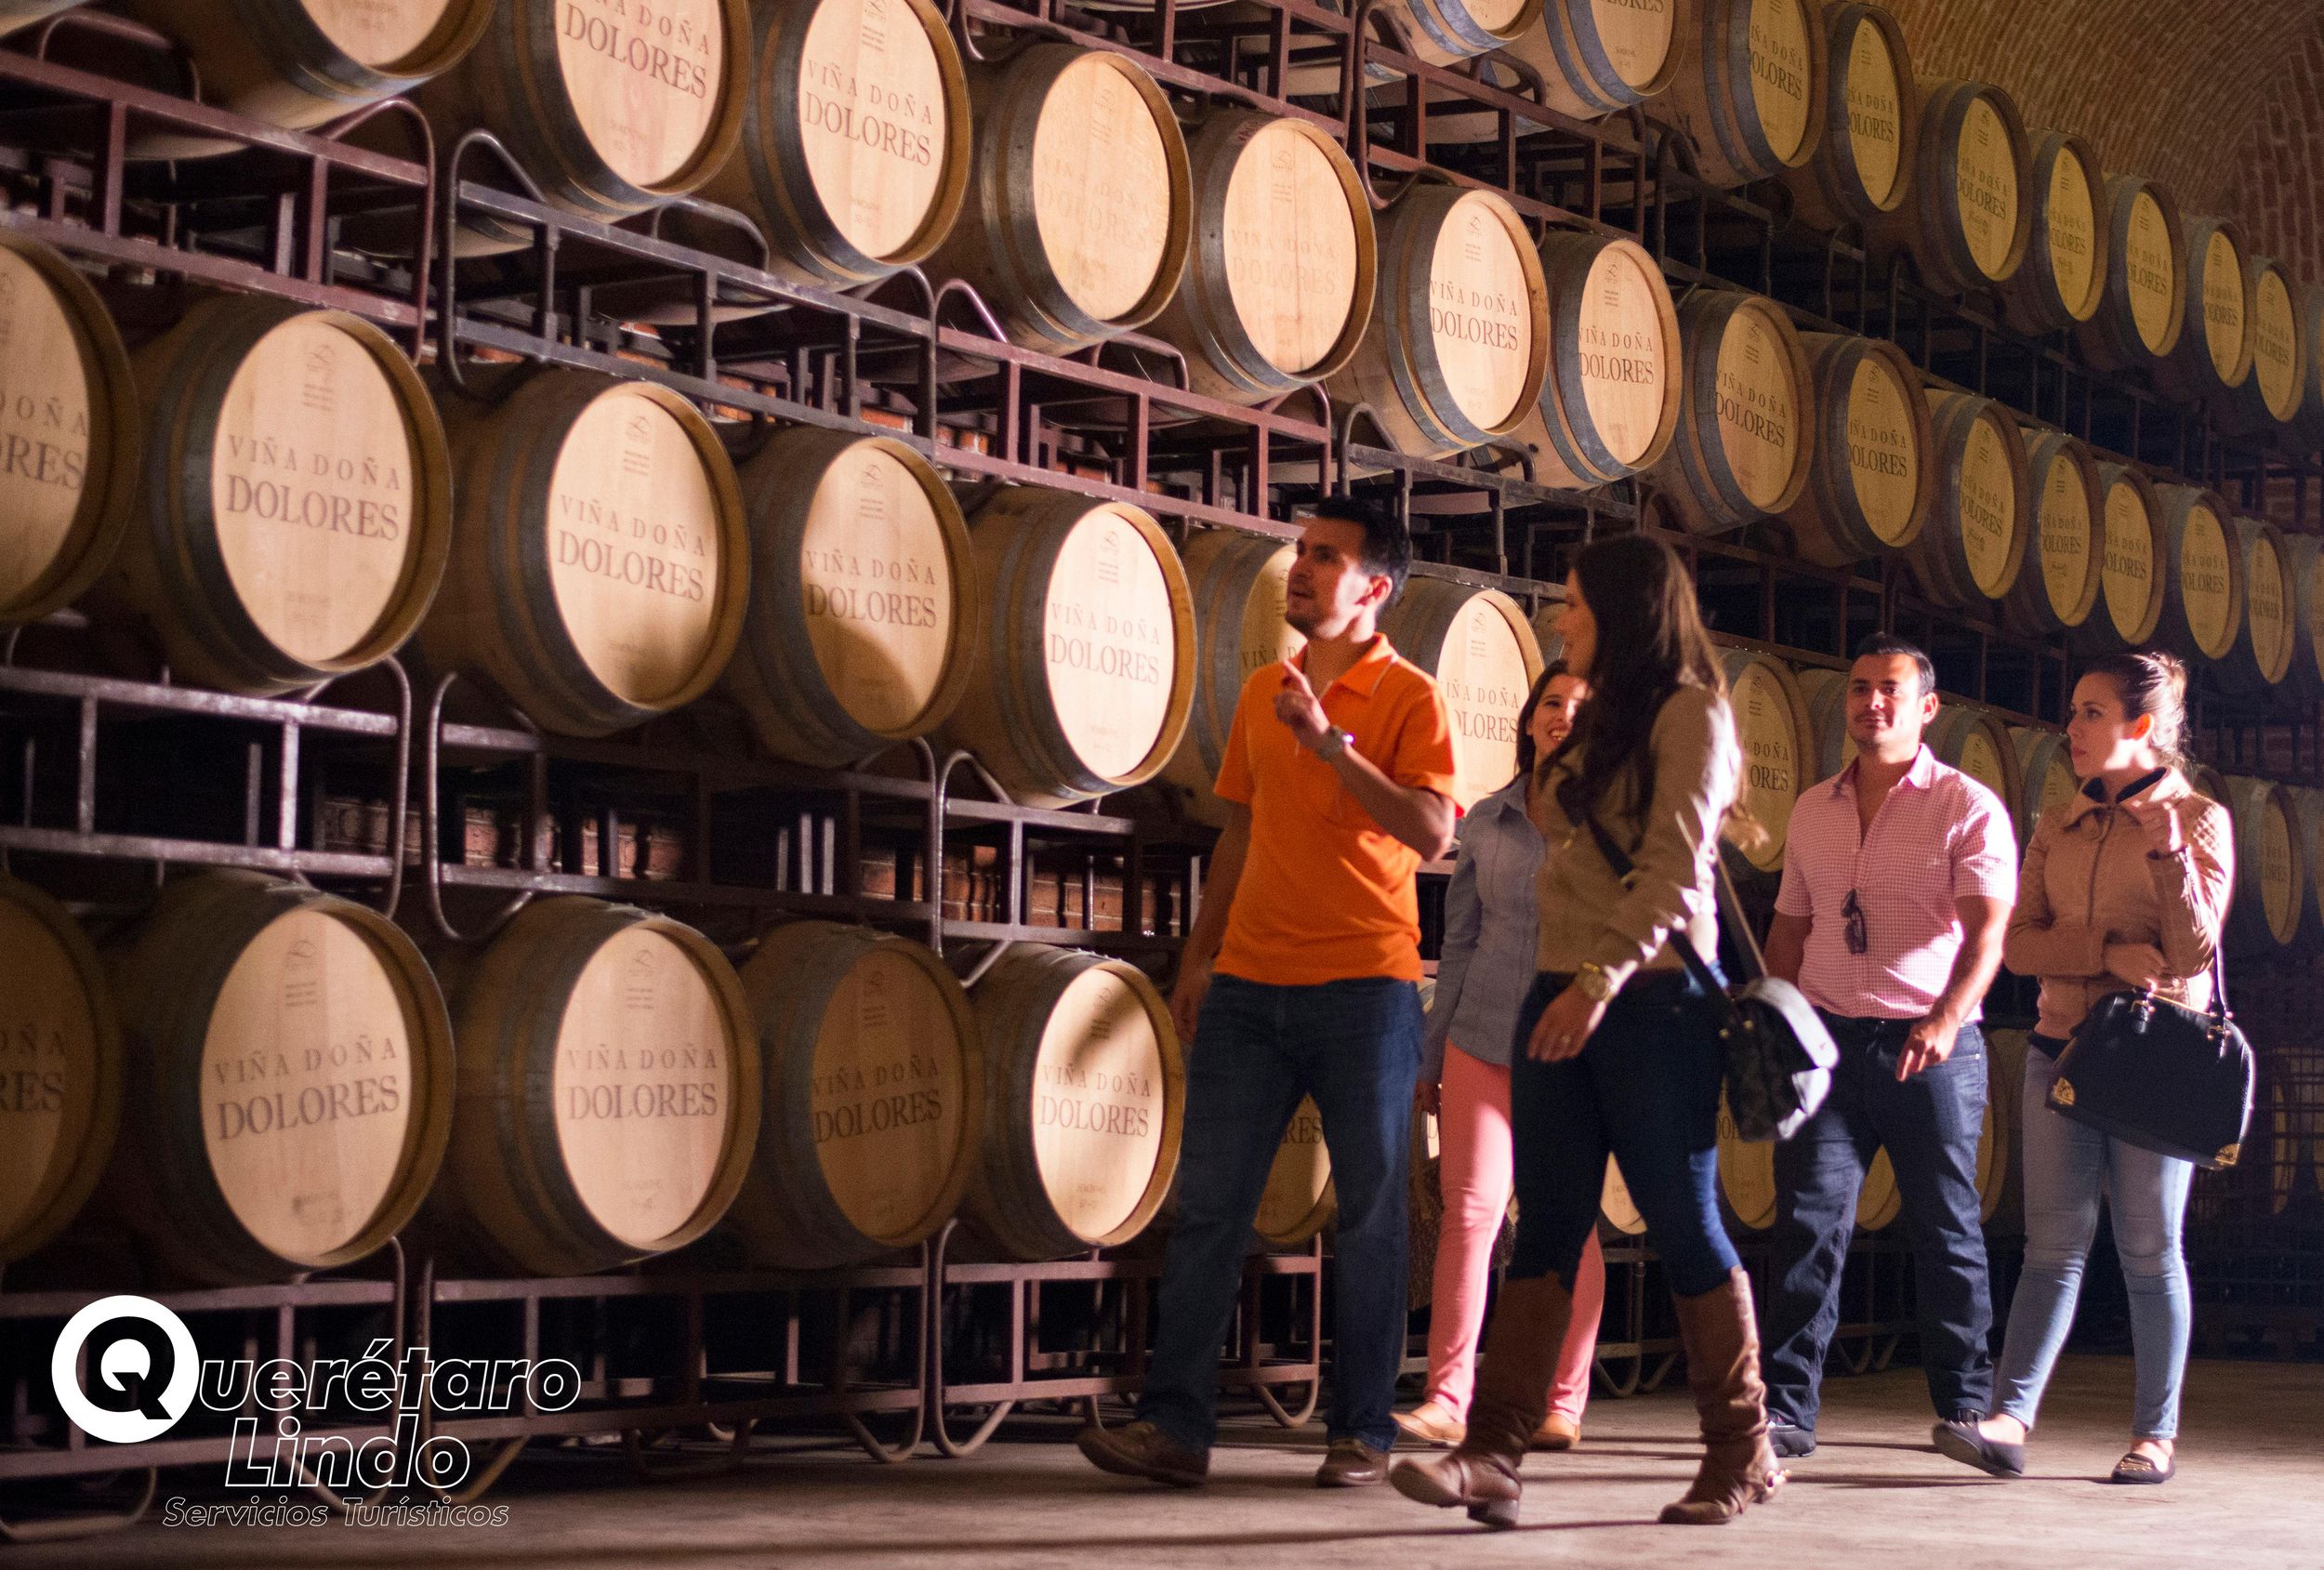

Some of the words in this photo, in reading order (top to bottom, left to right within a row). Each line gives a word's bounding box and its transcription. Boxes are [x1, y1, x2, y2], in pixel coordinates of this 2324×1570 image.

[639, 4, 710, 56] DOÑA
[563, 3, 707, 99] DOLORES
[1771, 39, 1803, 72] DOÑA
[808, 59, 858, 98] VIÑA
[870, 85, 932, 125] DOÑA
[1751, 50, 1802, 101] OLORES
[805, 90, 931, 166] DOLORES
[1849, 111, 1895, 143] OLORES
[1232, 256, 1337, 296] DOLORES
[1472, 291, 1518, 316] DOÑA
[1430, 307, 1518, 351] DOLORES
[1612, 331, 1653, 352] DOÑA
[1578, 351, 1655, 385] DOLORES
[0, 391, 86, 436] OÑA
[1749, 387, 1786, 419] DOÑA
[1850, 419, 1867, 440] IÑA
[1870, 428, 1907, 450] DOÑA
[228, 434, 297, 471] VIÑA
[313, 453, 400, 490] DOÑA
[226, 474, 399, 541] DOLORES
[561, 495, 619, 533] VIÑA
[632, 514, 706, 558] DOÑA
[558, 529, 704, 603] DOLORES
[805, 547, 862, 576] VIÑA
[872, 558, 936, 587] DOÑA
[2105, 552, 2146, 580] OLORES
[2185, 572, 2225, 594] OLORES
[807, 583, 937, 629] DOLORES
[1051, 602, 1097, 631] VIÑA
[1106, 616, 1160, 645] DOÑA
[1050, 633, 1160, 685] DOLORES
[1446, 679, 1471, 701] IÑA
[1478, 687, 1519, 708] DOÑA
[1455, 709, 1517, 744] LORES
[1753, 741, 1789, 761] DOÑA
[1750, 764, 1789, 792] ORES
[213, 1049, 291, 1086] VIÑA
[303, 1034, 398, 1072] DOÑA
[566, 1043, 627, 1071] VIÑA
[640, 1041, 719, 1071] DOÑA
[875, 1054, 939, 1088] DOÑA
[1042, 1063, 1088, 1089] VIÑA
[1097, 1072, 1151, 1098] DOÑA
[217, 1075, 401, 1141] DOLORES
[568, 1083, 719, 1120] DOLORES
[813, 1088, 943, 1143] DOLORES
[1039, 1096, 1149, 1138] DOLORES
